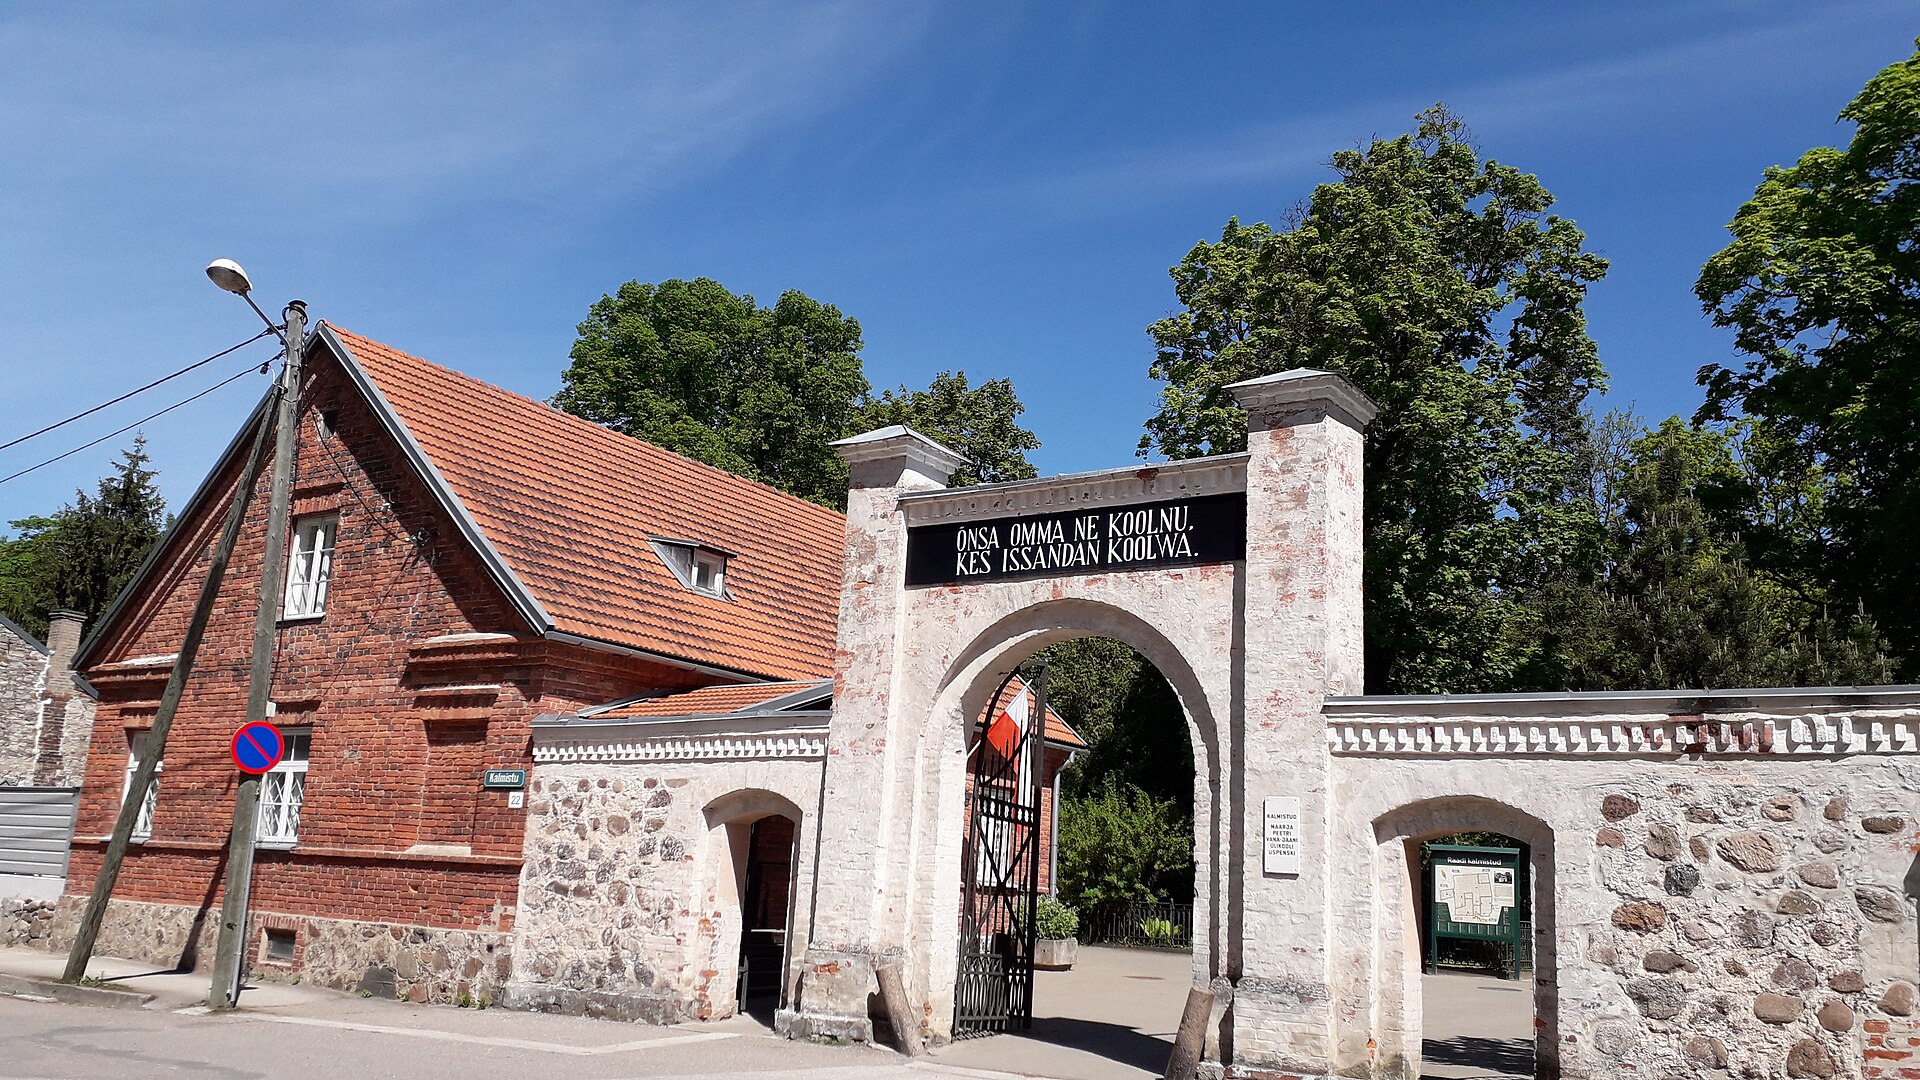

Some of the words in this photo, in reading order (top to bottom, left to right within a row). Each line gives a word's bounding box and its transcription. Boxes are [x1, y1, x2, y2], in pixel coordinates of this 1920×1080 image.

[956, 526, 999, 552] ÕNSA
[1010, 519, 1065, 547] OMMA
[1074, 515, 1100, 541] NE
[956, 550, 991, 576] KES
[1002, 540, 1100, 573] ISSANDAN
[1107, 532, 1199, 563] KOOLWA.
[489, 772, 519, 783] Kalmistu
[510, 795, 521, 805] 22
[1447, 856, 1467, 864] Raadi
[1467, 857, 1502, 866] kalmistud
